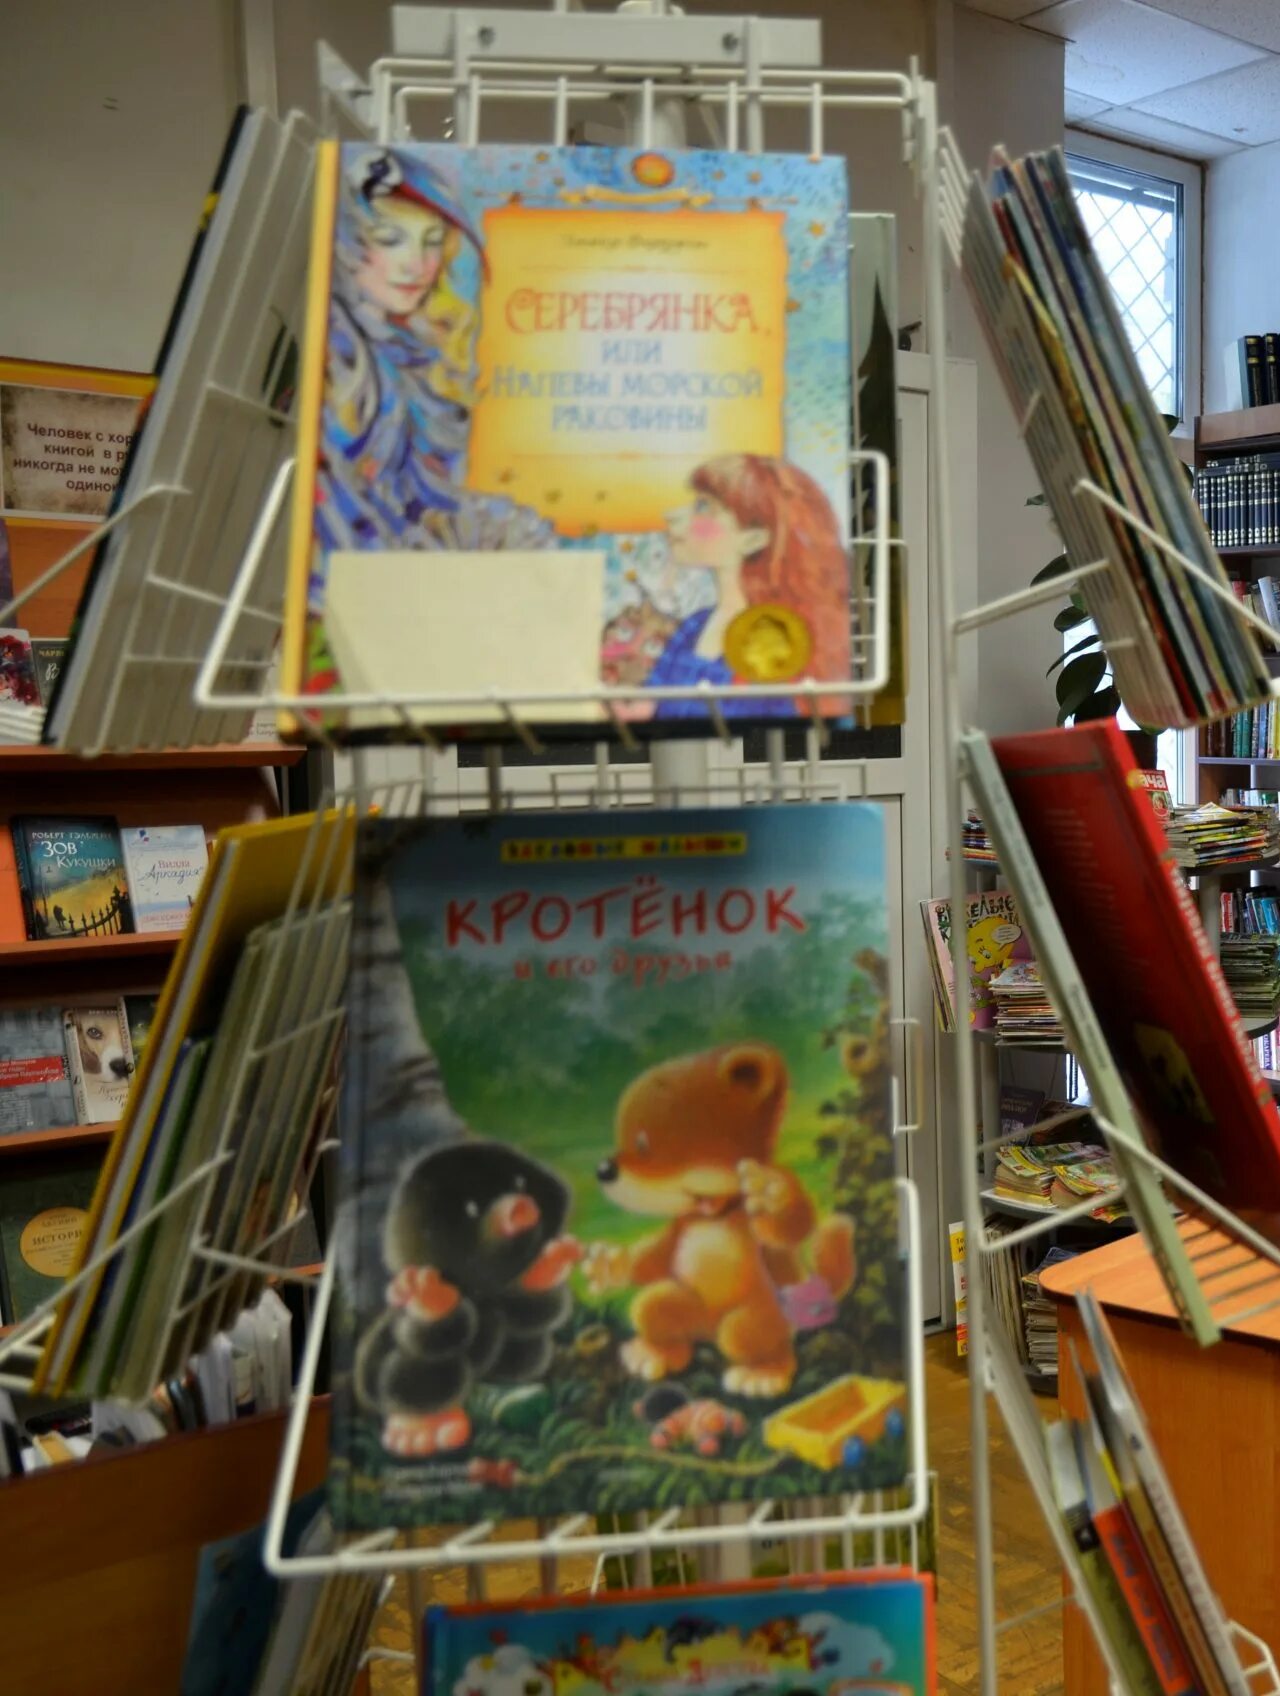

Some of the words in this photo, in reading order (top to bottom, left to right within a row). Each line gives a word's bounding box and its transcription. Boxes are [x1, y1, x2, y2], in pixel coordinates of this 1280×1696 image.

[27, 422, 91, 441] Человек
[95, 431, 103, 442] с
[44, 443, 95, 459] книгой
[103, 449, 112, 460] в
[13, 458, 74, 474] никогда
[78, 462, 96, 475] не
[445, 873, 807, 947] КРОТЁНОК
[546, 955, 598, 979] его
